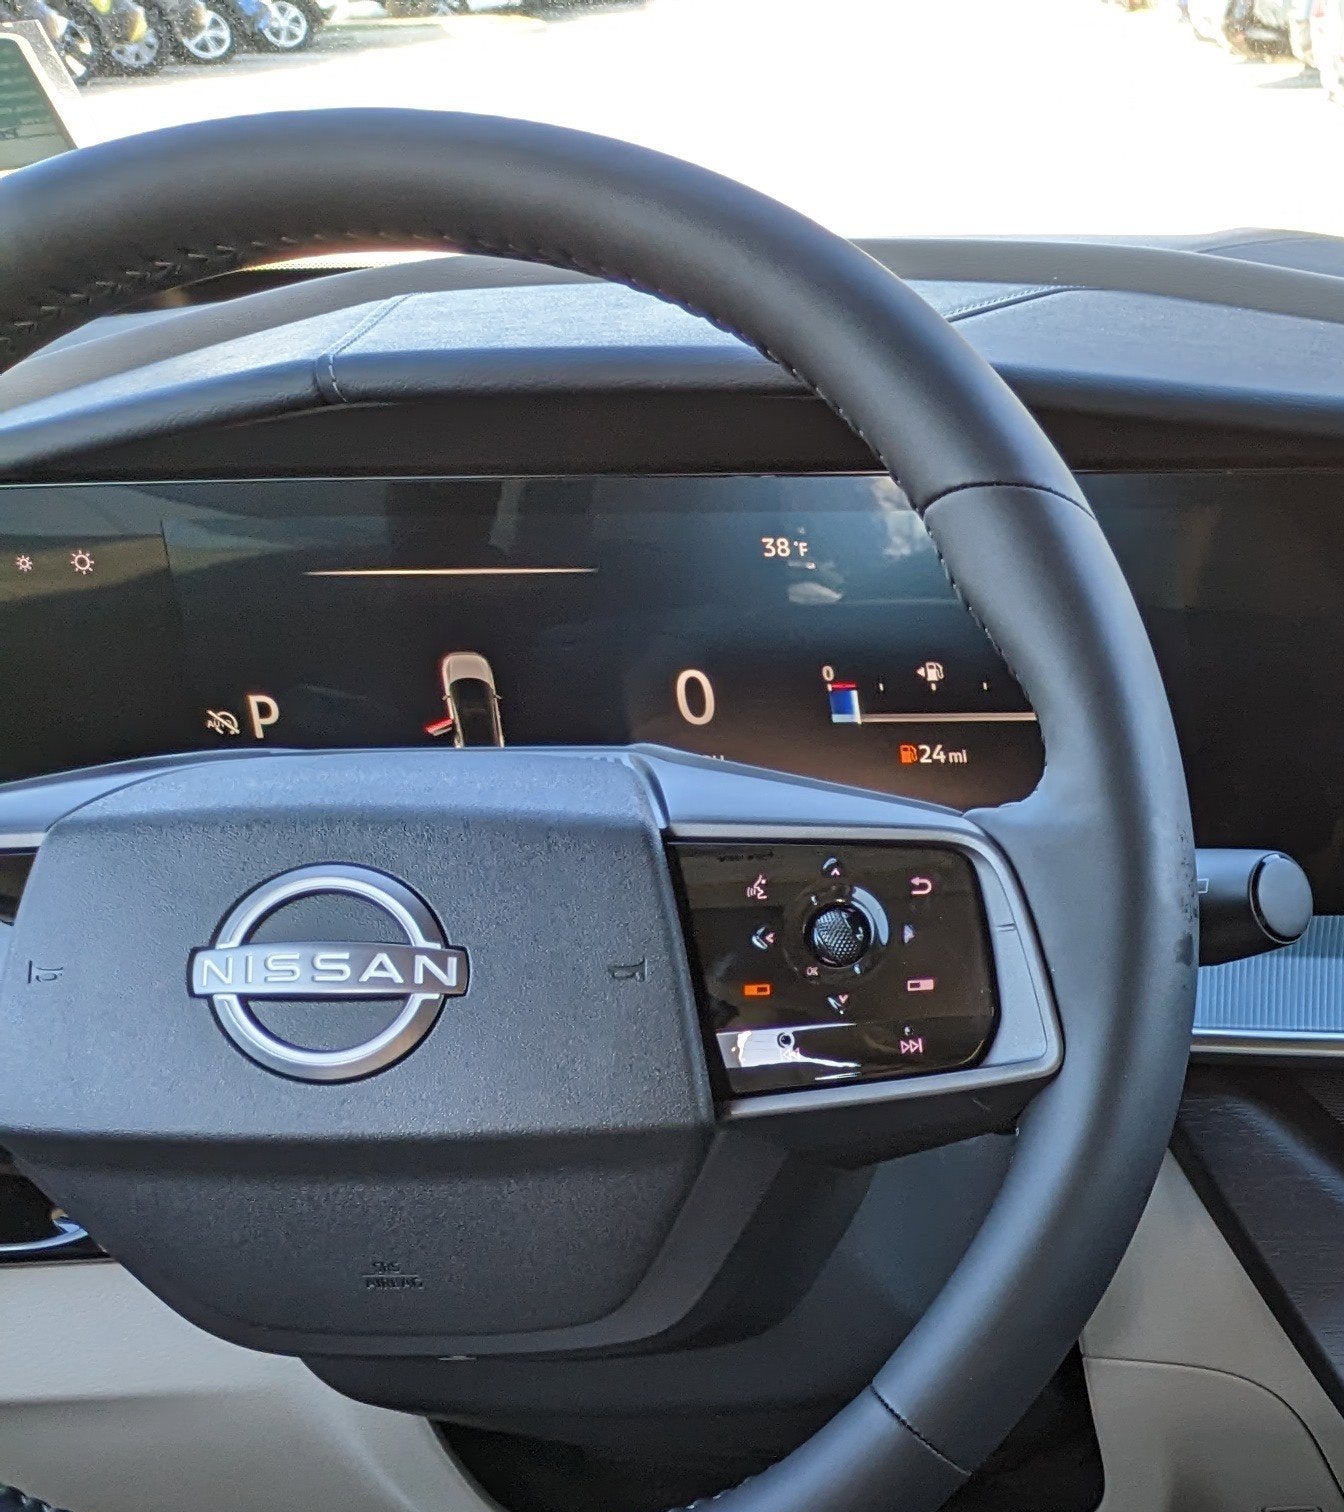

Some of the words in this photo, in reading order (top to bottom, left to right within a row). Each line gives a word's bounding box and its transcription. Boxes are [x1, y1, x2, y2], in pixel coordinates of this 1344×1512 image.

[761, 537, 791, 558] 38
[822, 665, 835, 682] 0
[676, 669, 716, 726] 0
[248, 694, 280, 739] P
[918, 744, 946, 764] 24
[948, 748, 968, 763] mi
[201, 952, 458, 988] NISSAN
